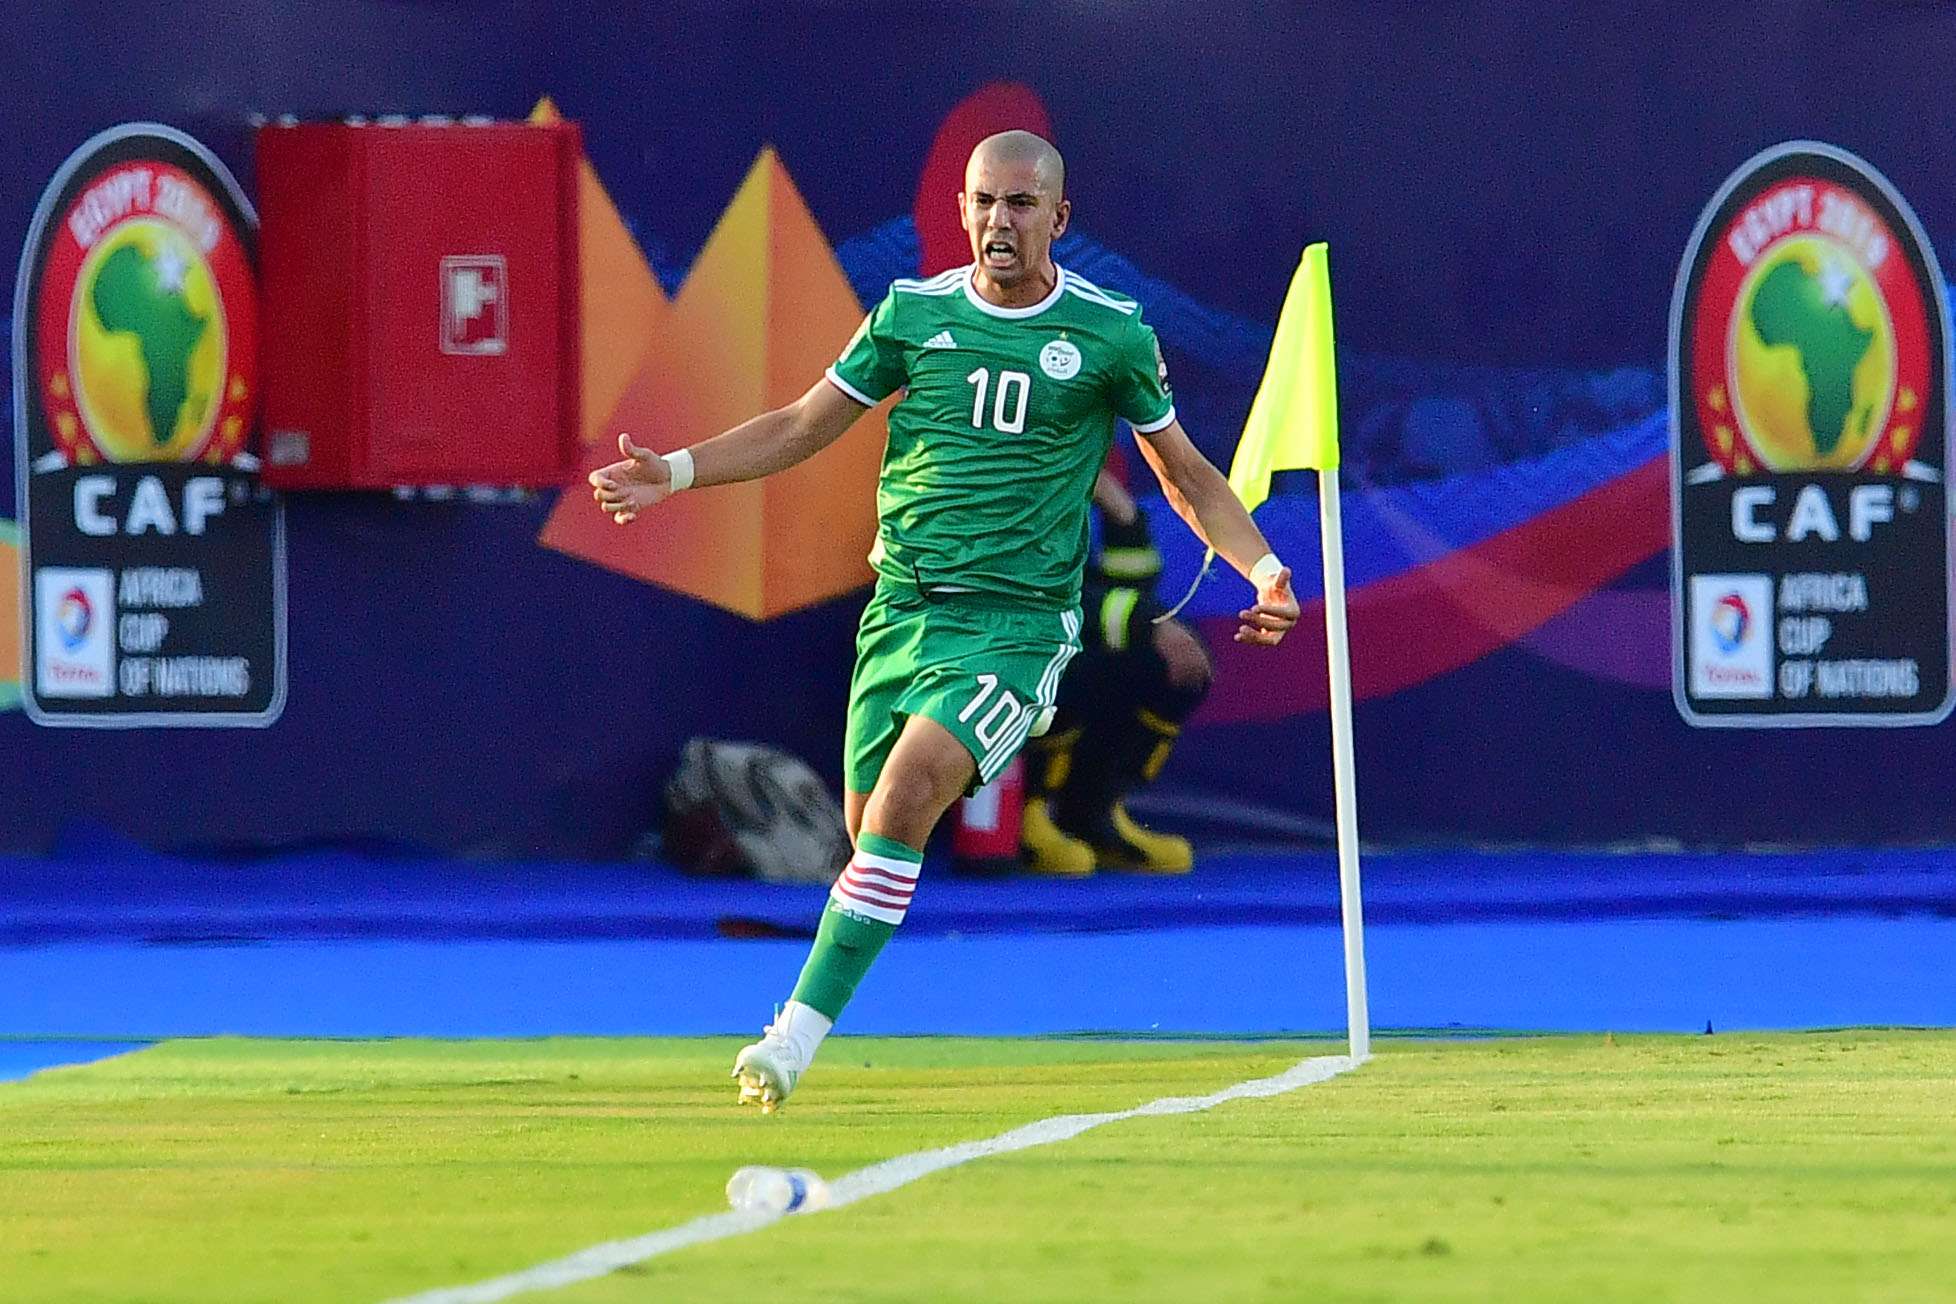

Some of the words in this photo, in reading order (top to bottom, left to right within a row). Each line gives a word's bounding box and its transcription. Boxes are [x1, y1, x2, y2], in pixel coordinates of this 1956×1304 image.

[1727, 184, 1815, 267] EGYPT
[966, 367, 1031, 434] 10
[73, 474, 228, 537] CAF
[1731, 484, 1896, 543] CAF
[118, 566, 204, 607] AFRICA
[1778, 572, 1869, 613] AFRICA
[119, 612, 170, 652] CUP
[1779, 616, 1832, 656] CUP
[119, 656, 152, 696] OF
[153, 656, 250, 696] NATIONS
[1779, 660, 1814, 699] OF
[1815, 658, 1920, 698] NATIONS
[957, 673, 1023, 751] 10
